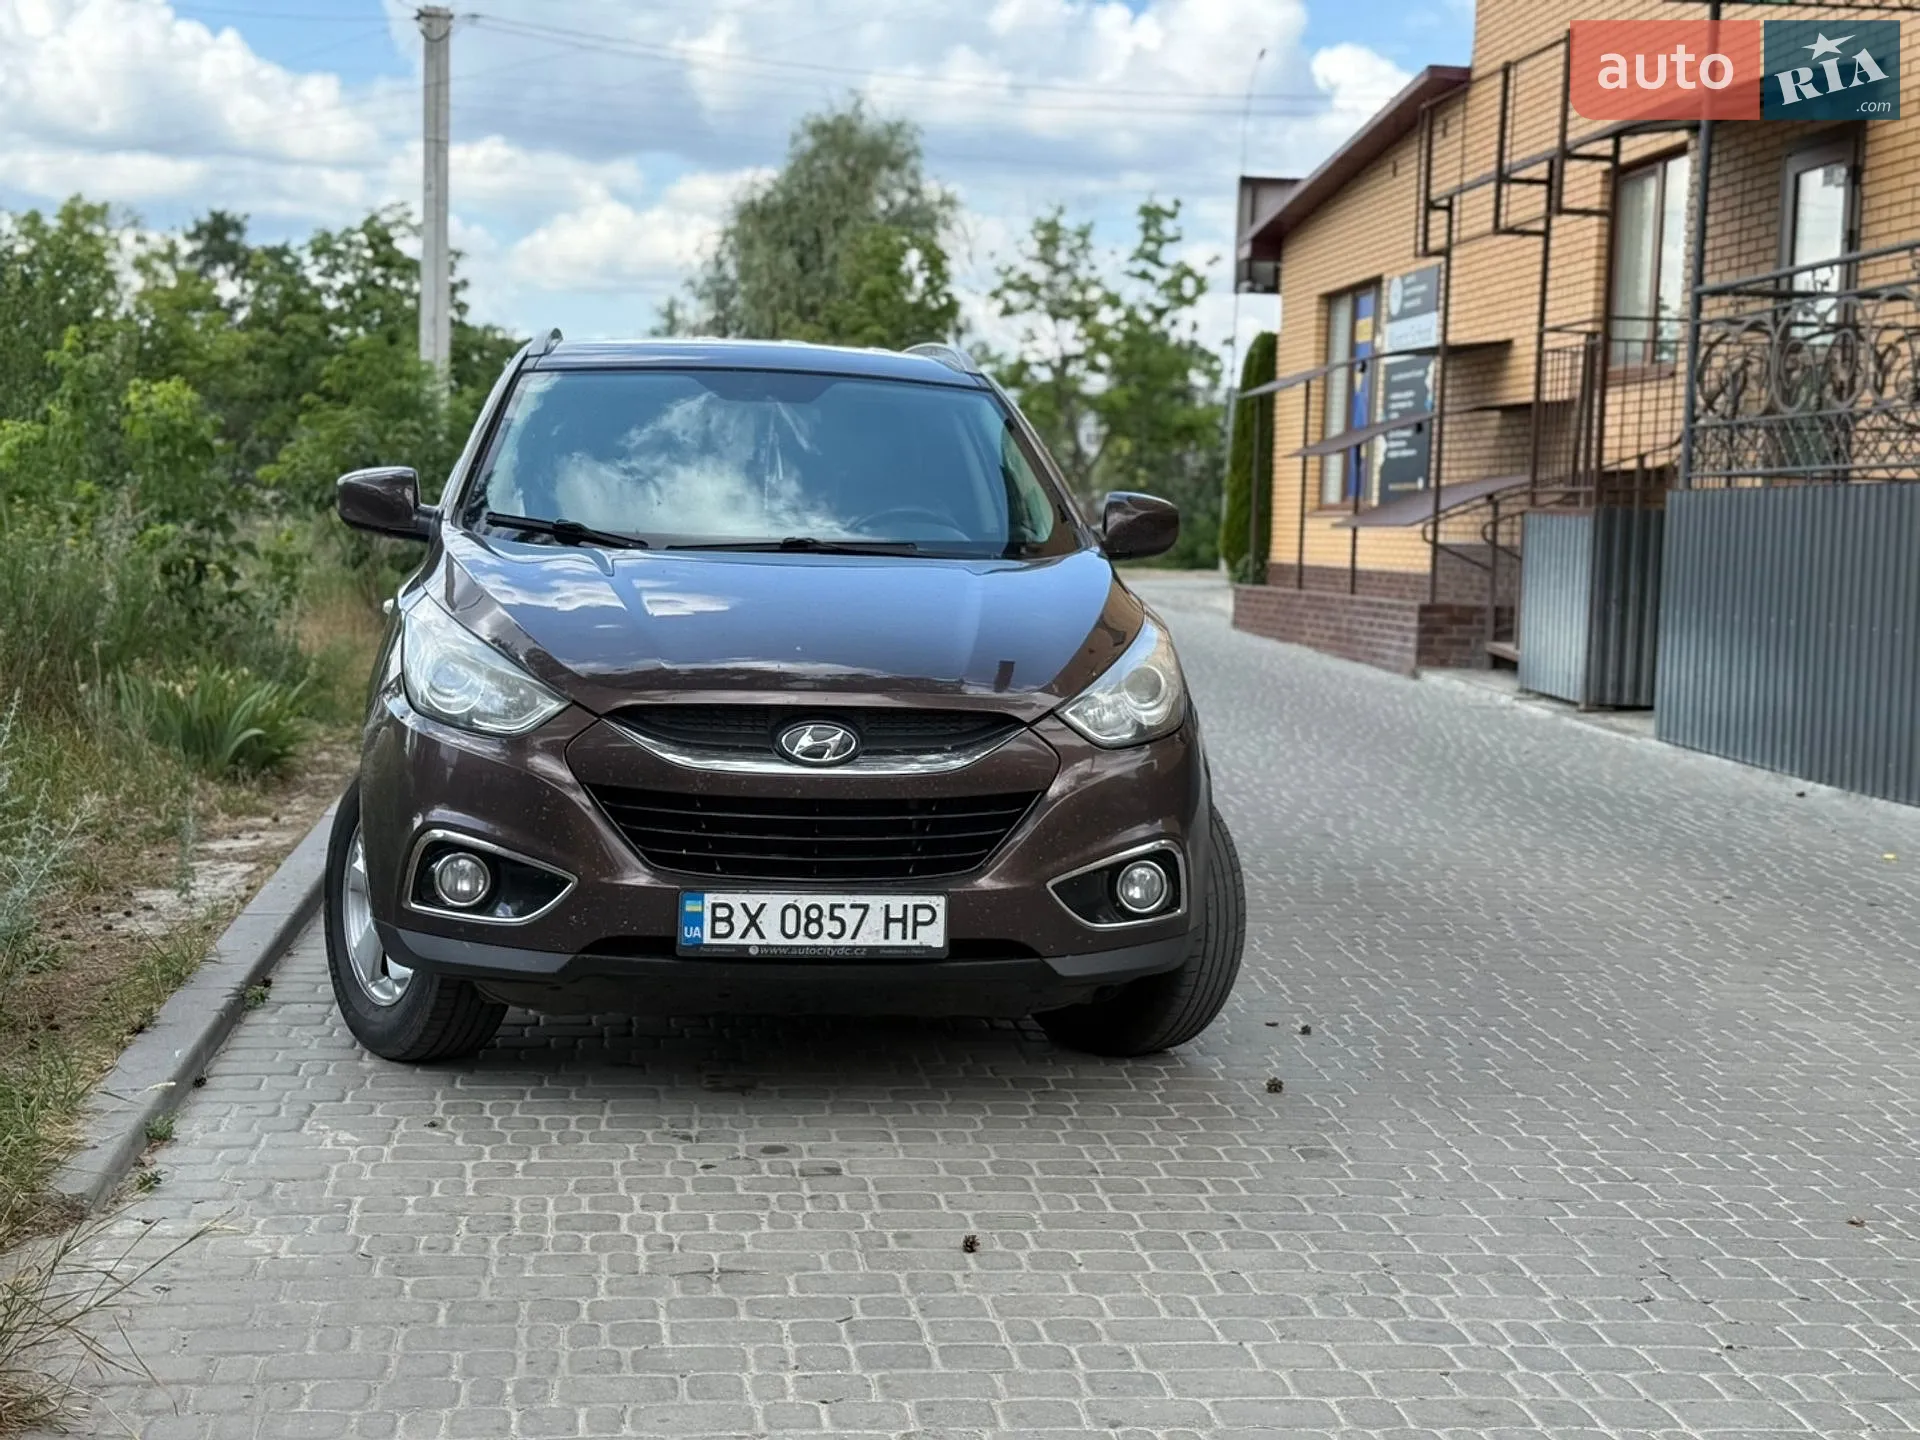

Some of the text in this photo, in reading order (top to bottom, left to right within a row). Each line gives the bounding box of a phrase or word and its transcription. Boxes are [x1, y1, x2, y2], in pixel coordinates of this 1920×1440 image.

[710, 902, 937, 941] BX 0857 HP
[684, 926, 702, 939] UA
[760, 946, 867, 957] www.autocitydc.cz
